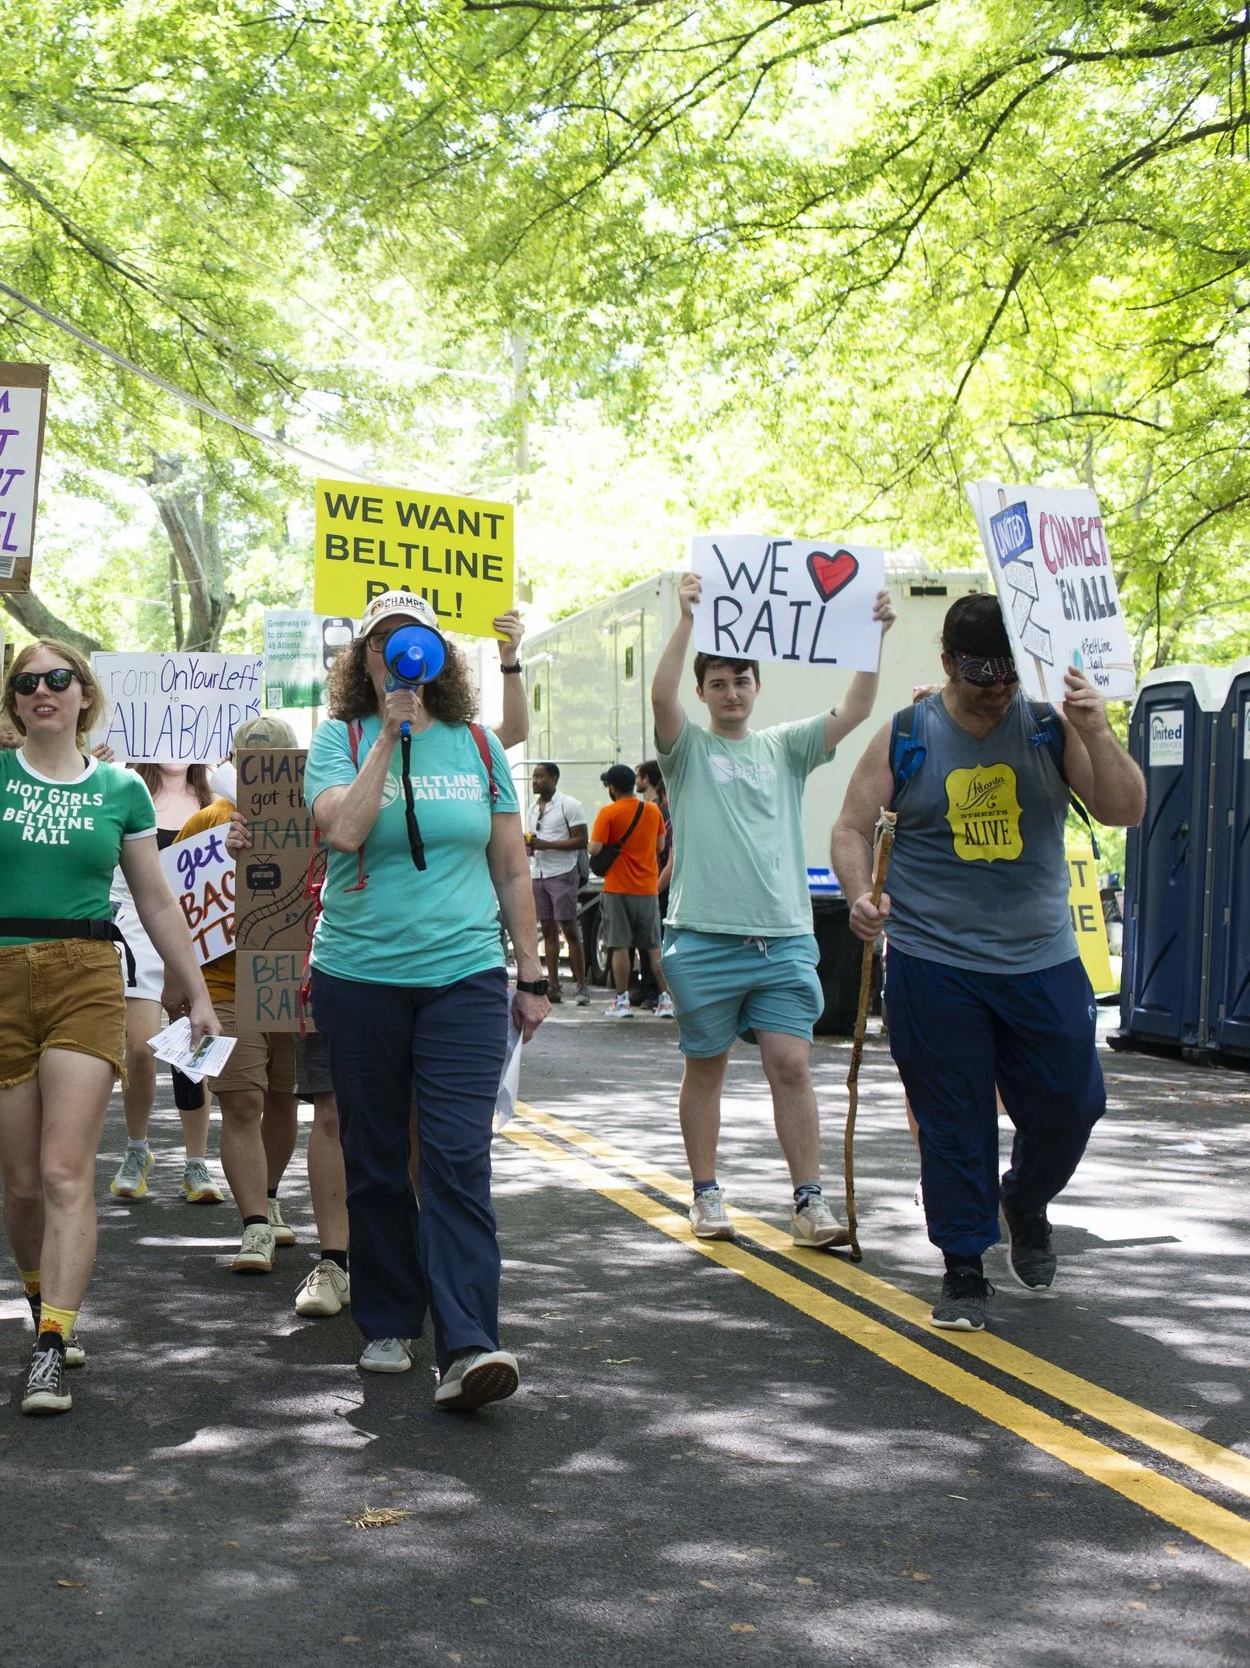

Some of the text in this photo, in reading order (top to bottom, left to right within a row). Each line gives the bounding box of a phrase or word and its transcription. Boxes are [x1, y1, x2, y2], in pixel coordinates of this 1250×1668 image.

[324, 492, 505, 540] WE WANT
[993, 511, 1107, 575] UNITED CONNECT
[325, 533, 504, 583] BELTLINE
[712, 541, 792, 597] WE
[366, 580, 462, 618] RL!
[384, 597, 426, 612] CHAMPS
[1080, 575, 1117, 622] ALL
[267, 620, 299, 628] Greenway
[268, 631, 302, 639] to connect
[713, 595, 837, 664] RAIL
[169, 692, 180, 703] to
[1152, 724, 1182, 740] United
[6, 779, 104, 807] HOT GIRLS
[400, 774, 482, 788] ELTLINE
[956, 773, 1006, 809] Atlanta
[22, 797, 82, 817] WANT
[251, 790, 279, 816] got
[961, 810, 1008, 819] STREETS
[2, 807, 95, 831] BELTLINE
[964, 819, 1012, 846] ALIVE
[22, 825, 70, 845] RAIL
[247, 817, 327, 850] TRAI
[177, 833, 225, 890] get
